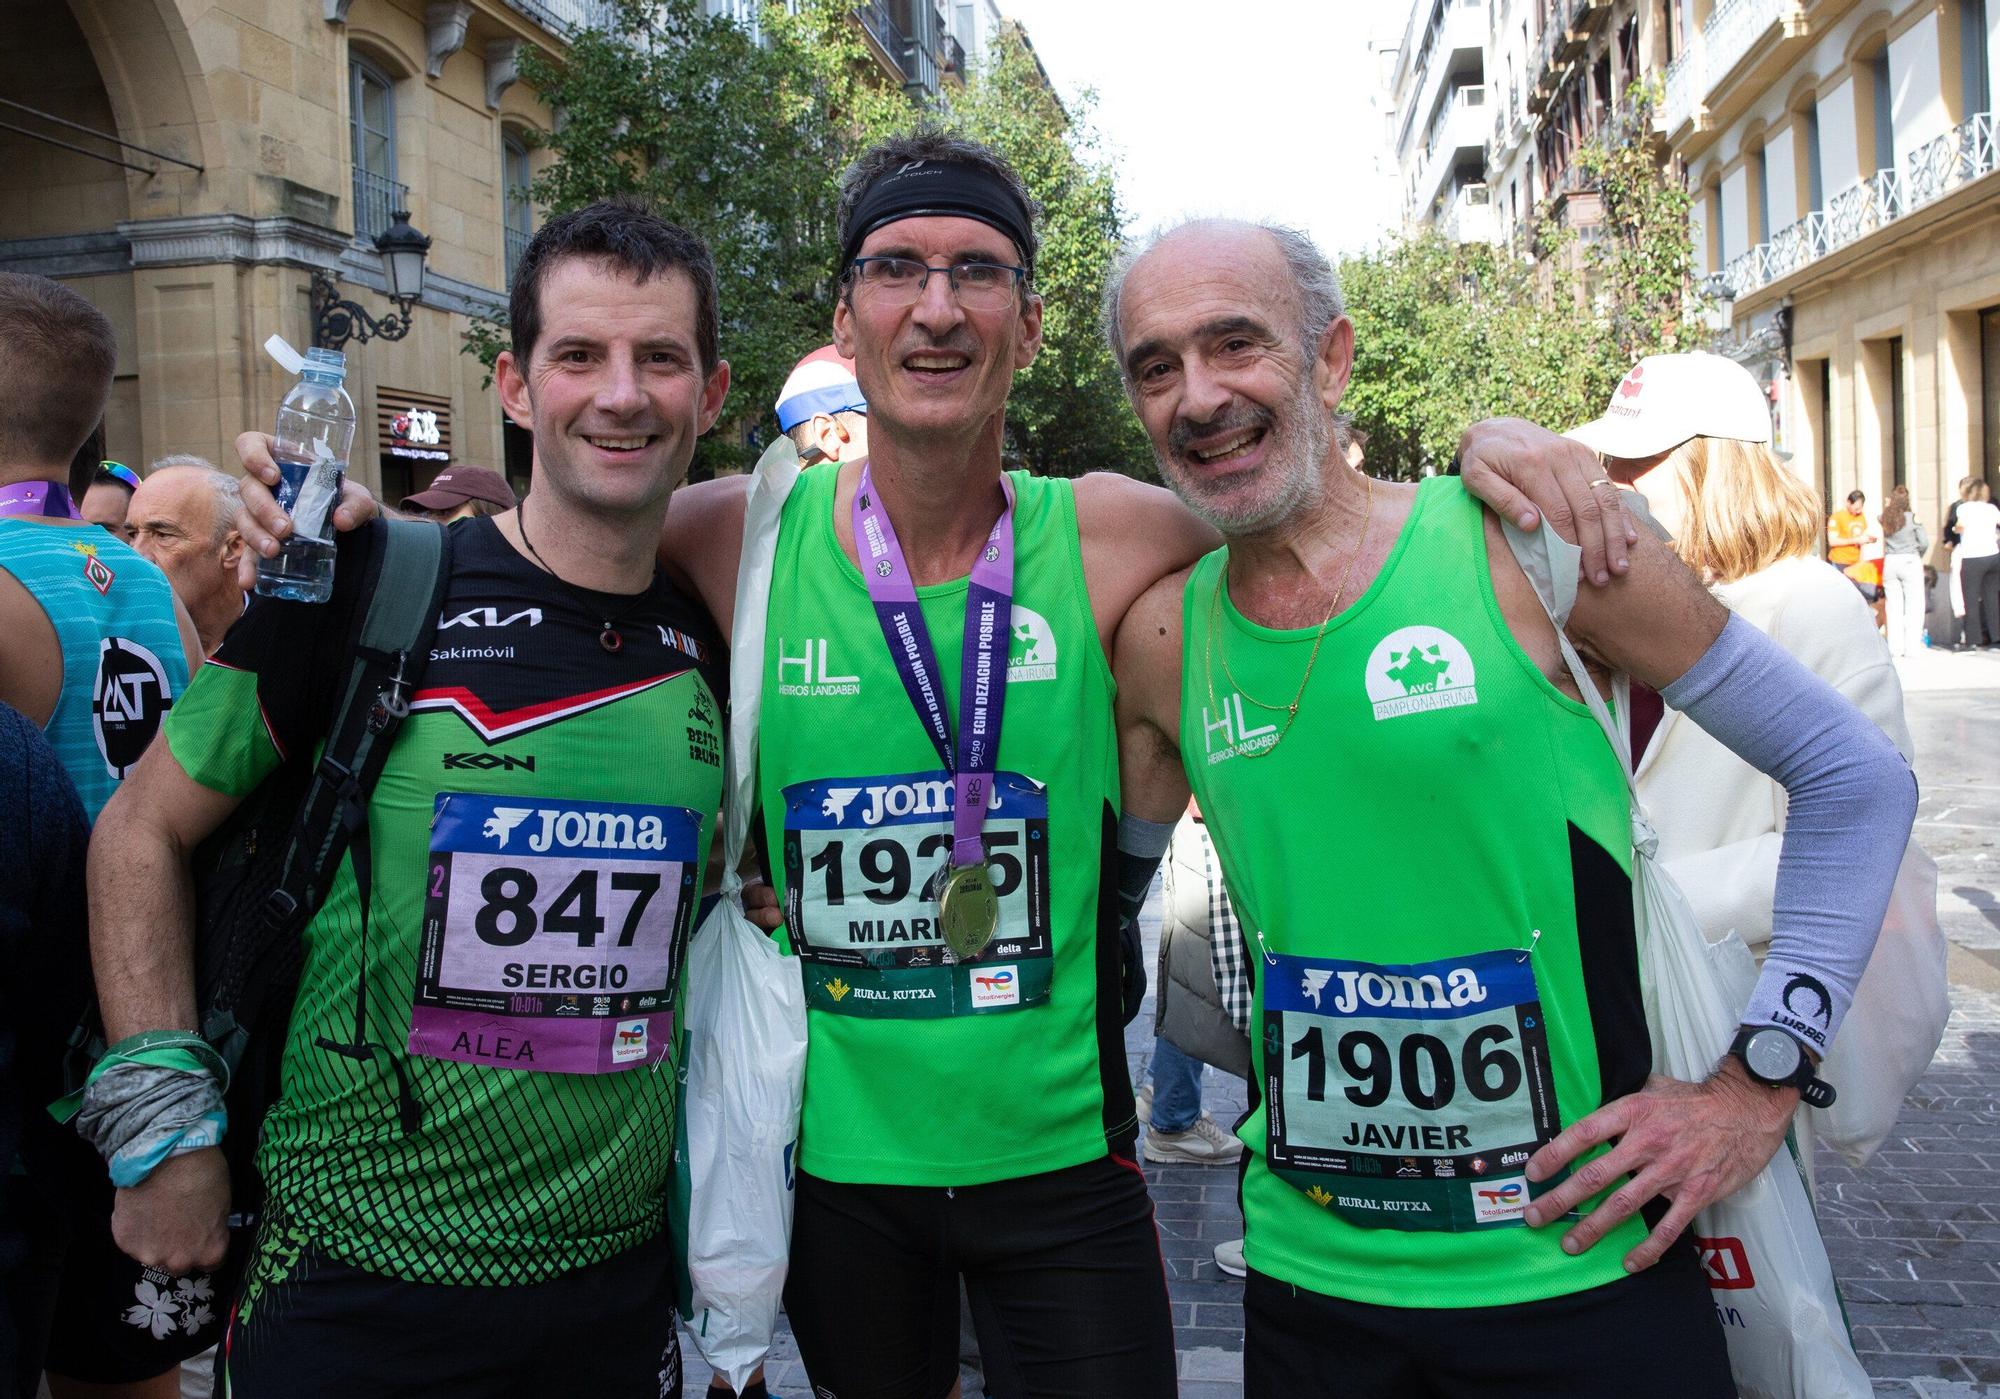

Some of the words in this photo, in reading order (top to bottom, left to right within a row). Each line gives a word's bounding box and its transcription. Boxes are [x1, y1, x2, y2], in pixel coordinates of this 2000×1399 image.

[904, 169, 943, 178] TOUCH
[893, 611, 921, 661] POSIBLE
[978, 601, 995, 650] POSIBLE
[430, 646, 514, 661] Sakimóvil
[779, 638, 860, 684] HL
[811, 684, 860, 696] LANDABEN
[911, 660, 939, 712] DEZAGUN
[975, 652, 992, 705] DEZAGUN
[1409, 682, 1433, 695] AVC
[931, 712, 947, 740] EGIN
[973, 707, 988, 735] EGIN
[1203, 693, 1276, 752] HL
[970, 740, 981, 768] 50/50
[529, 809, 667, 852] Joma
[431, 864, 445, 898] 2
[474, 867, 661, 948] 847
[997, 944, 1021, 955] delta
[502, 963, 628, 989] SERGIO
[639, 996, 656, 1006] delta
[854, 988, 890, 1000] RURAL
[893, 989, 936, 999] KUTXA
[977, 993, 1015, 1001] TotalEnergies
[1335, 967, 1487, 1014] Joma
[1771, 1011, 1827, 1047] LURBEL
[452, 1031, 535, 1063] ALEA
[1291, 1024, 1522, 1111] 1906
[1342, 1122, 1472, 1150] JAVIER
[1501, 1151, 1529, 1164] delta
[1338, 1196, 1380, 1210] RURAL
[1383, 1199, 1431, 1212] KUTXA
[143, 1269, 170, 1287] BERRI
